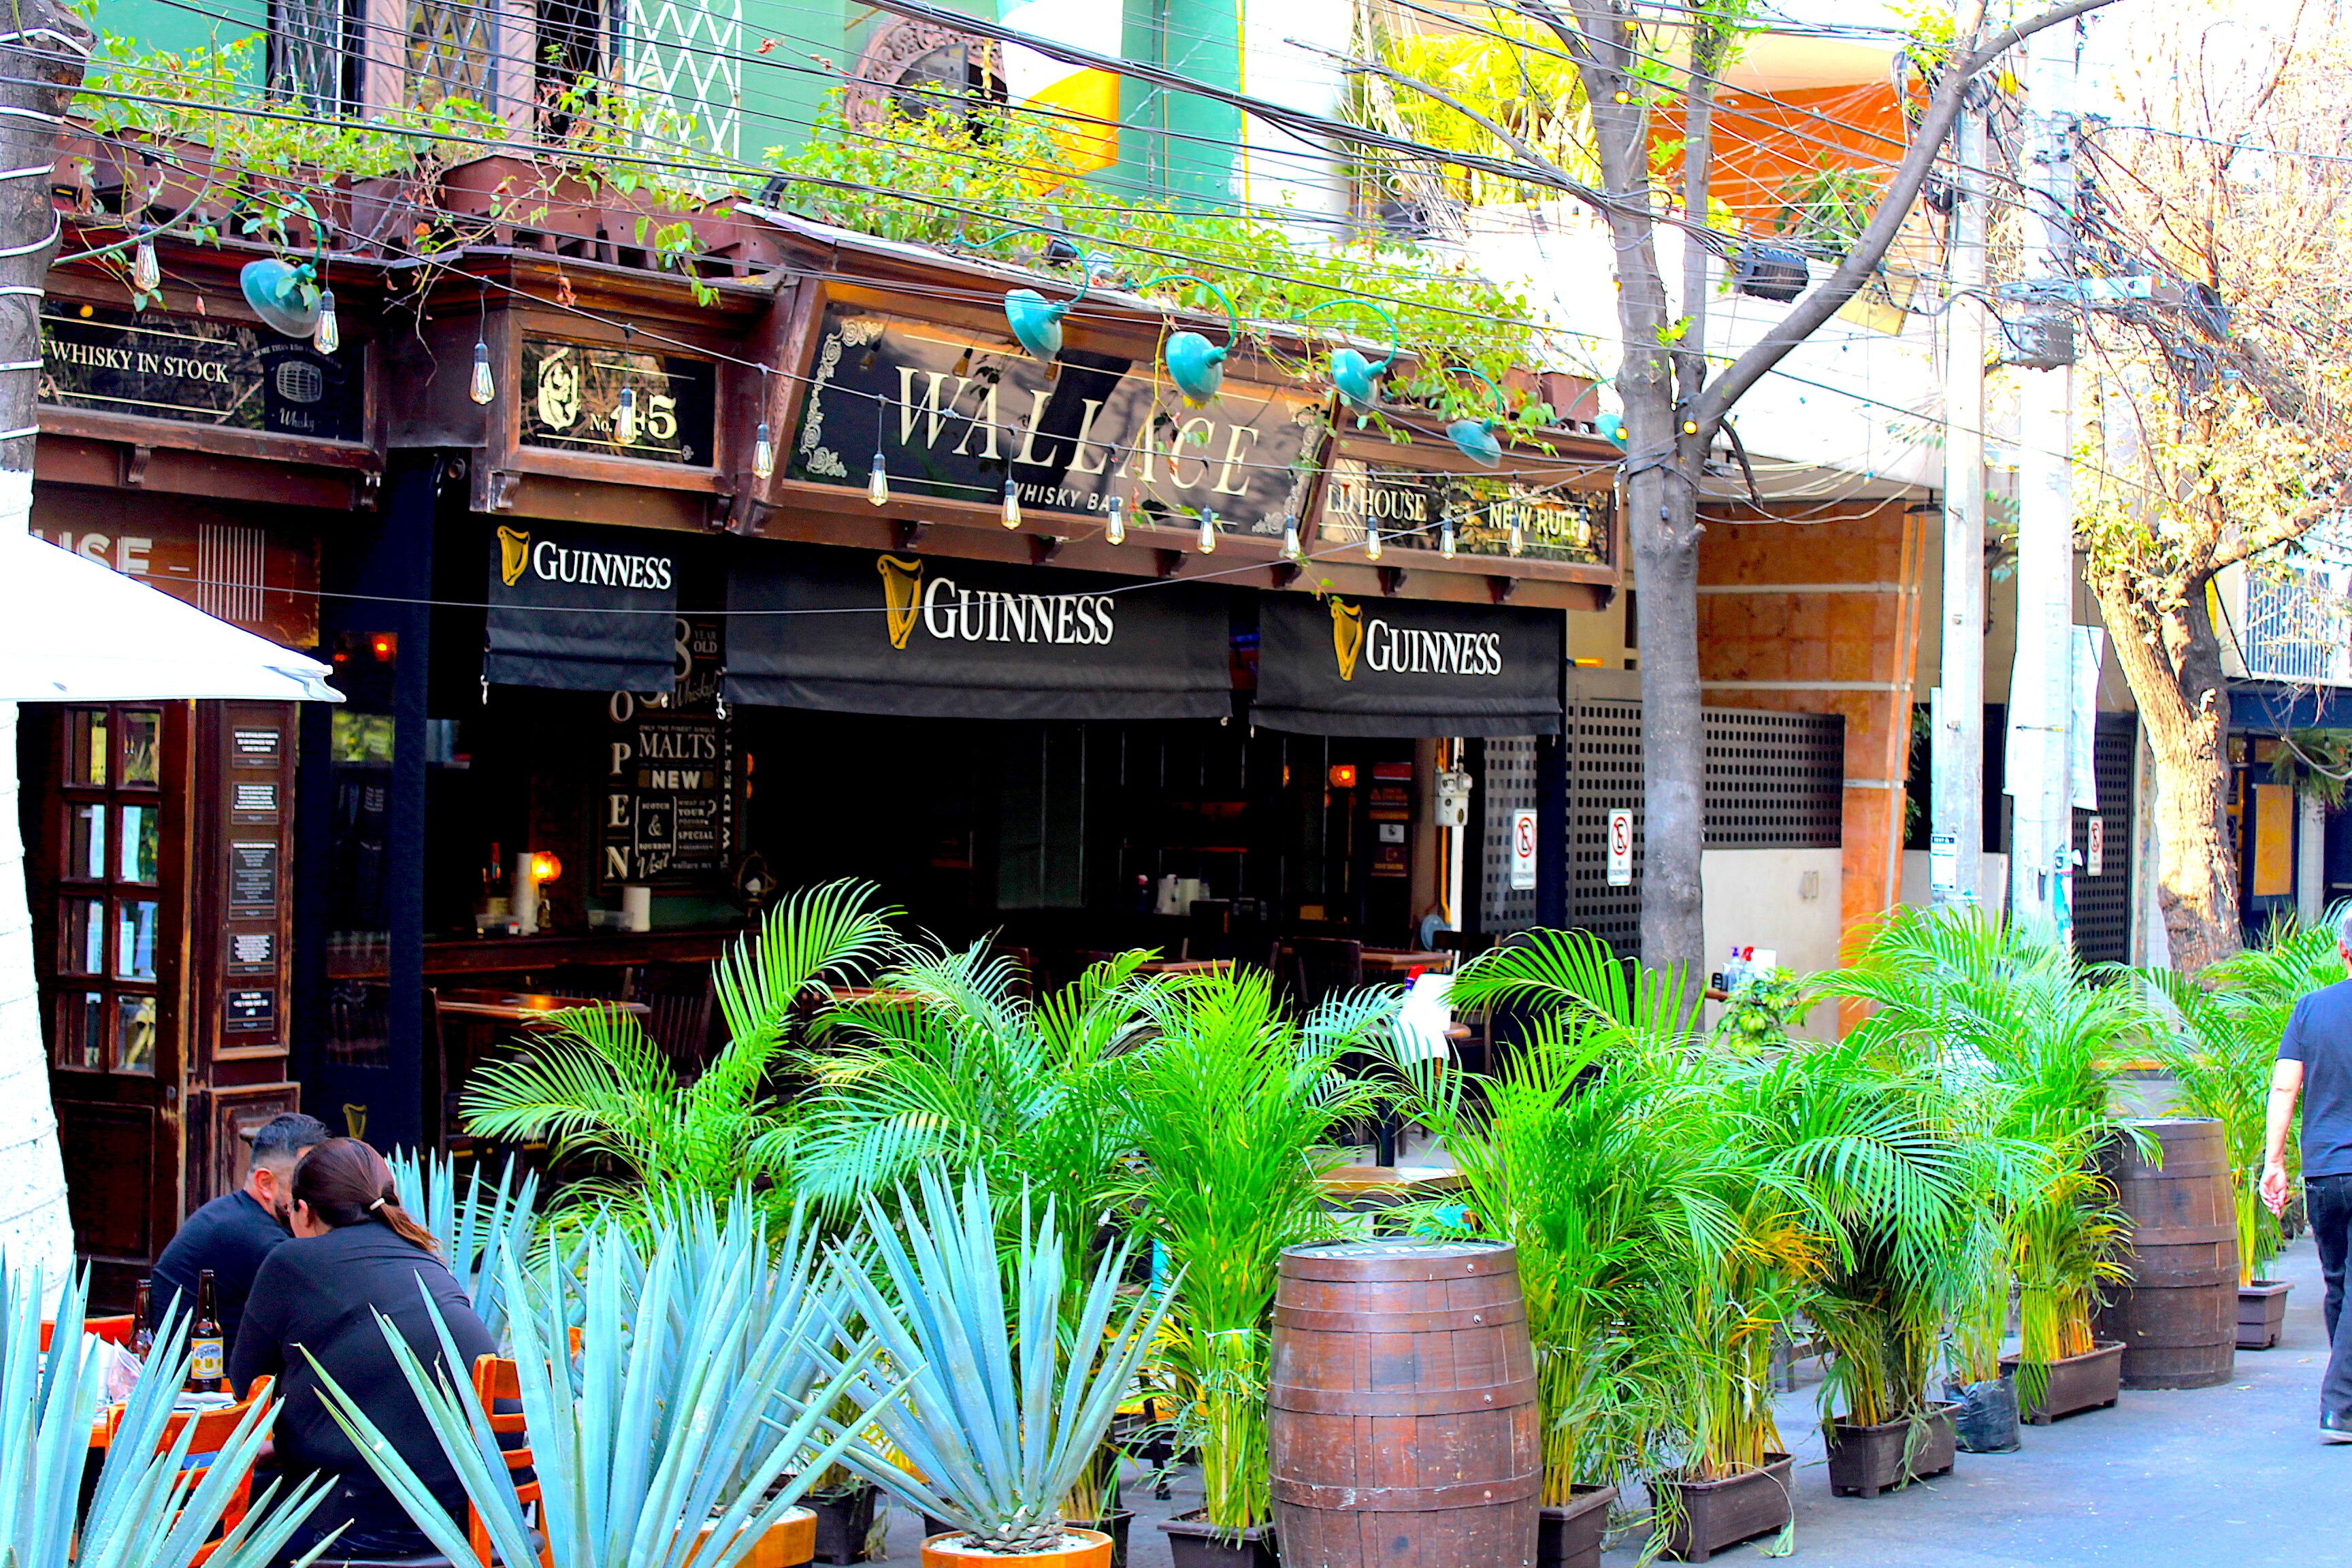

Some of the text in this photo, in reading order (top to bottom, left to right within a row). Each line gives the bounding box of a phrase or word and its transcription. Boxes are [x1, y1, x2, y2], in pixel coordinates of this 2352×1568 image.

[49, 340, 133, 371] WHISKY
[137, 352, 159, 374] IN
[163, 356, 230, 384] STOCK
[589, 412, 612, 432] No.
[895, 366, 1259, 497] WALLACE
[1358, 487, 1428, 522] HOUSE
[1488, 501, 1533, 533] NEW
[533, 540, 672, 590] GUINNESS
[923, 577, 1116, 645] GUINNESS
[693, 640, 718, 654] OLD
[1366, 619, 1502, 676] GUINNESS
[638, 732, 716, 760] MALTS
[651, 770, 700, 790] NEW
[648, 814, 663, 836] &
[679, 808, 705, 817] YOUR
[678, 830, 714, 840] SPECIAL
